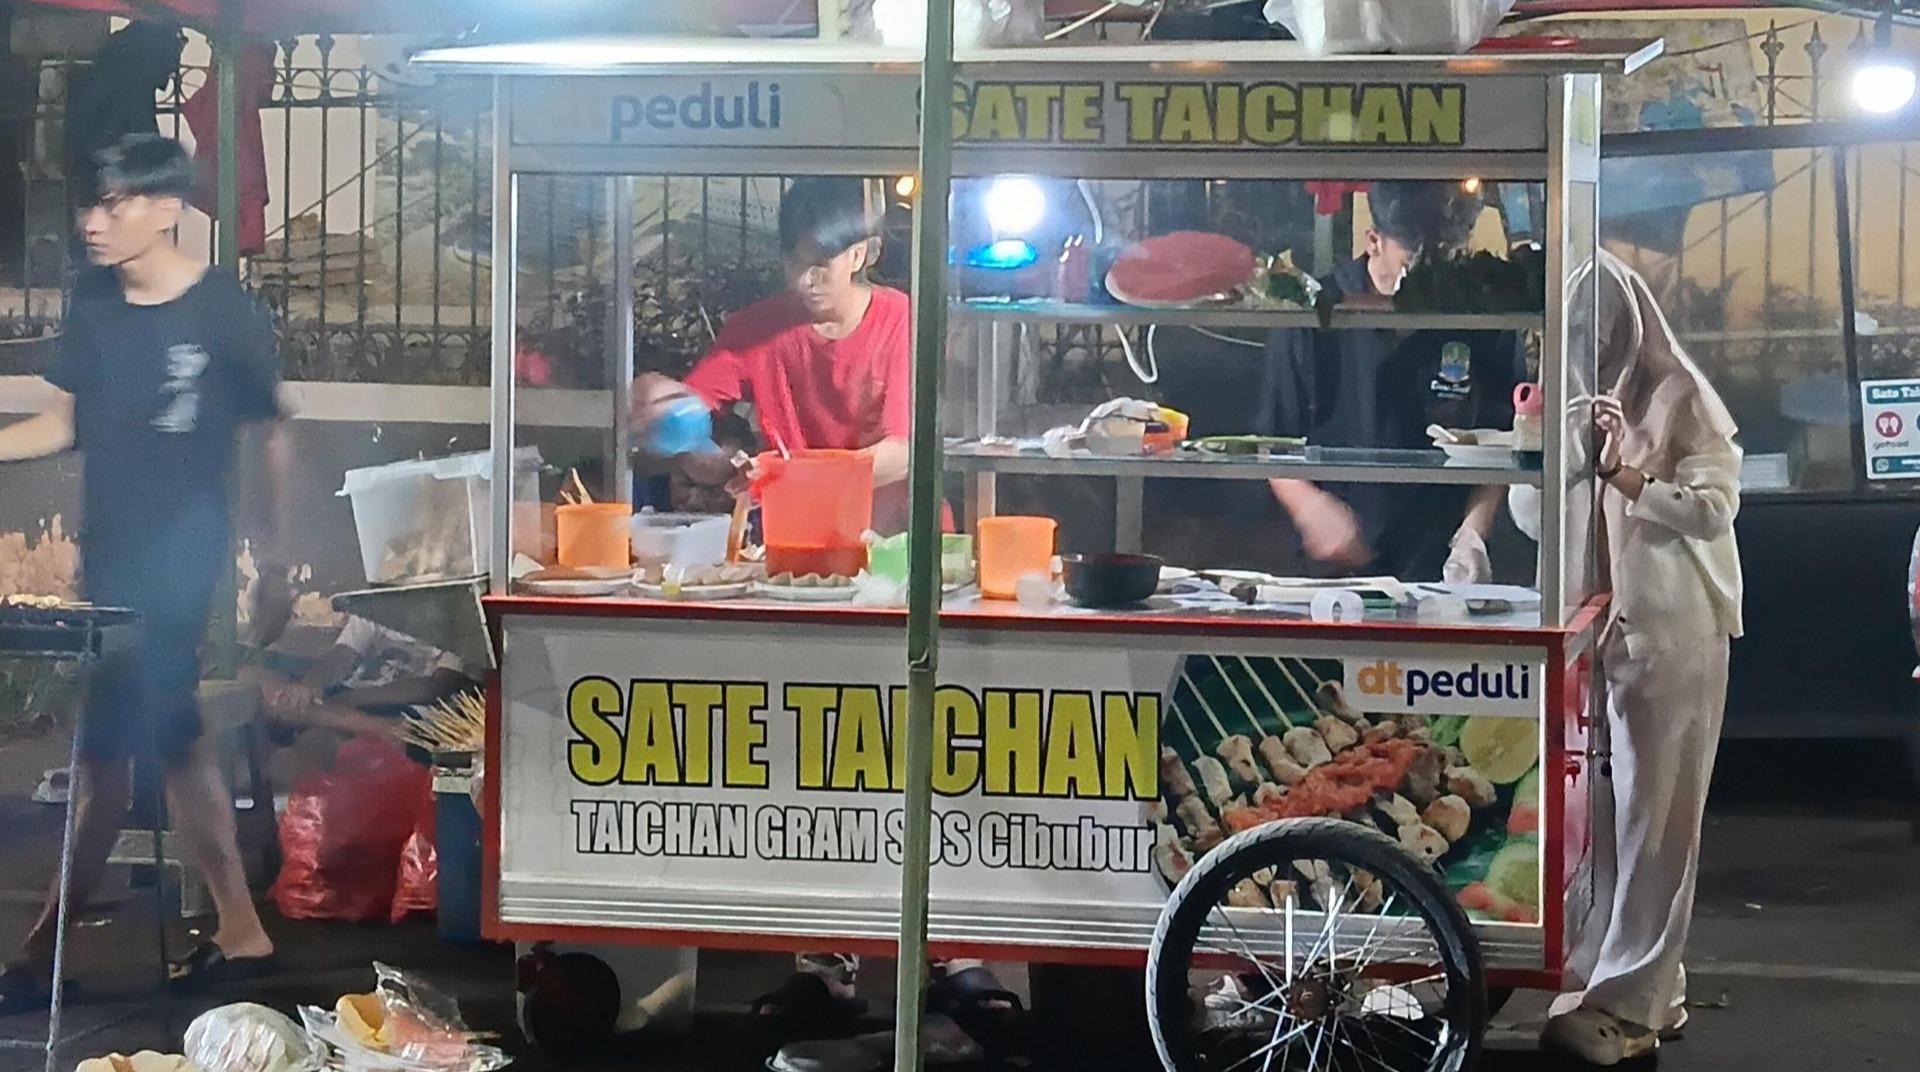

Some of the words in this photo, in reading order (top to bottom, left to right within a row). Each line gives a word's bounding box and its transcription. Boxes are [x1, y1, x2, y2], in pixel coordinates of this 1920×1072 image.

[1114, 81, 1466, 147] TAICHAN
[567, 675, 769, 789] SATE
[783, 682, 1162, 802] TAICHAN
[571, 800, 747, 858] TAICHAN
[755, 805, 877, 863] GRAM
[978, 811, 1157, 873] Cibubur
